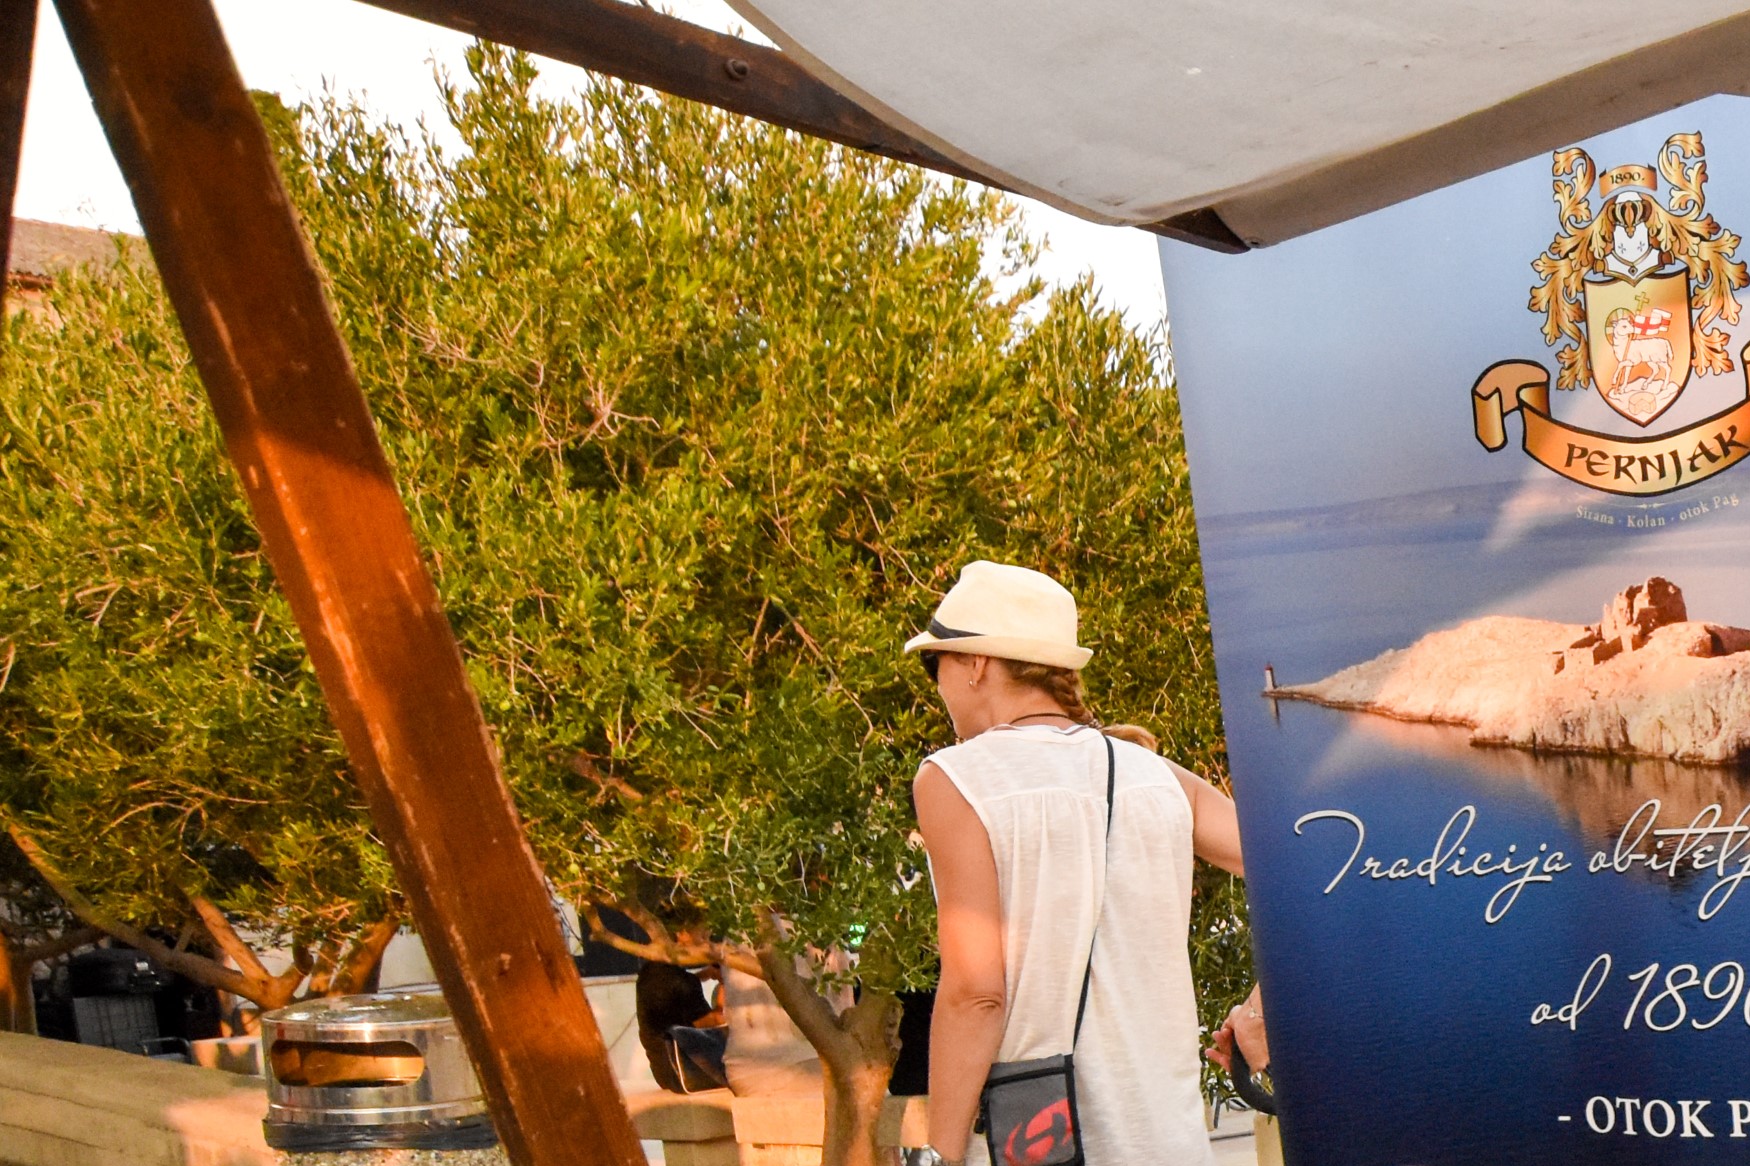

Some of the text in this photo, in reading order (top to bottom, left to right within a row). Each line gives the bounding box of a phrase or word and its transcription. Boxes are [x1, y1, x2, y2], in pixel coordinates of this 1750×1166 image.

[1564, 424, 1750, 486] PERNJAK
[1576, 492, 1740, 529] Sirana Kolan otok Pag
[1294, 805, 1573, 925] Tradicija
[1530, 953, 1613, 1032] od
[1585, 1096, 1715, 1138] OTOK
